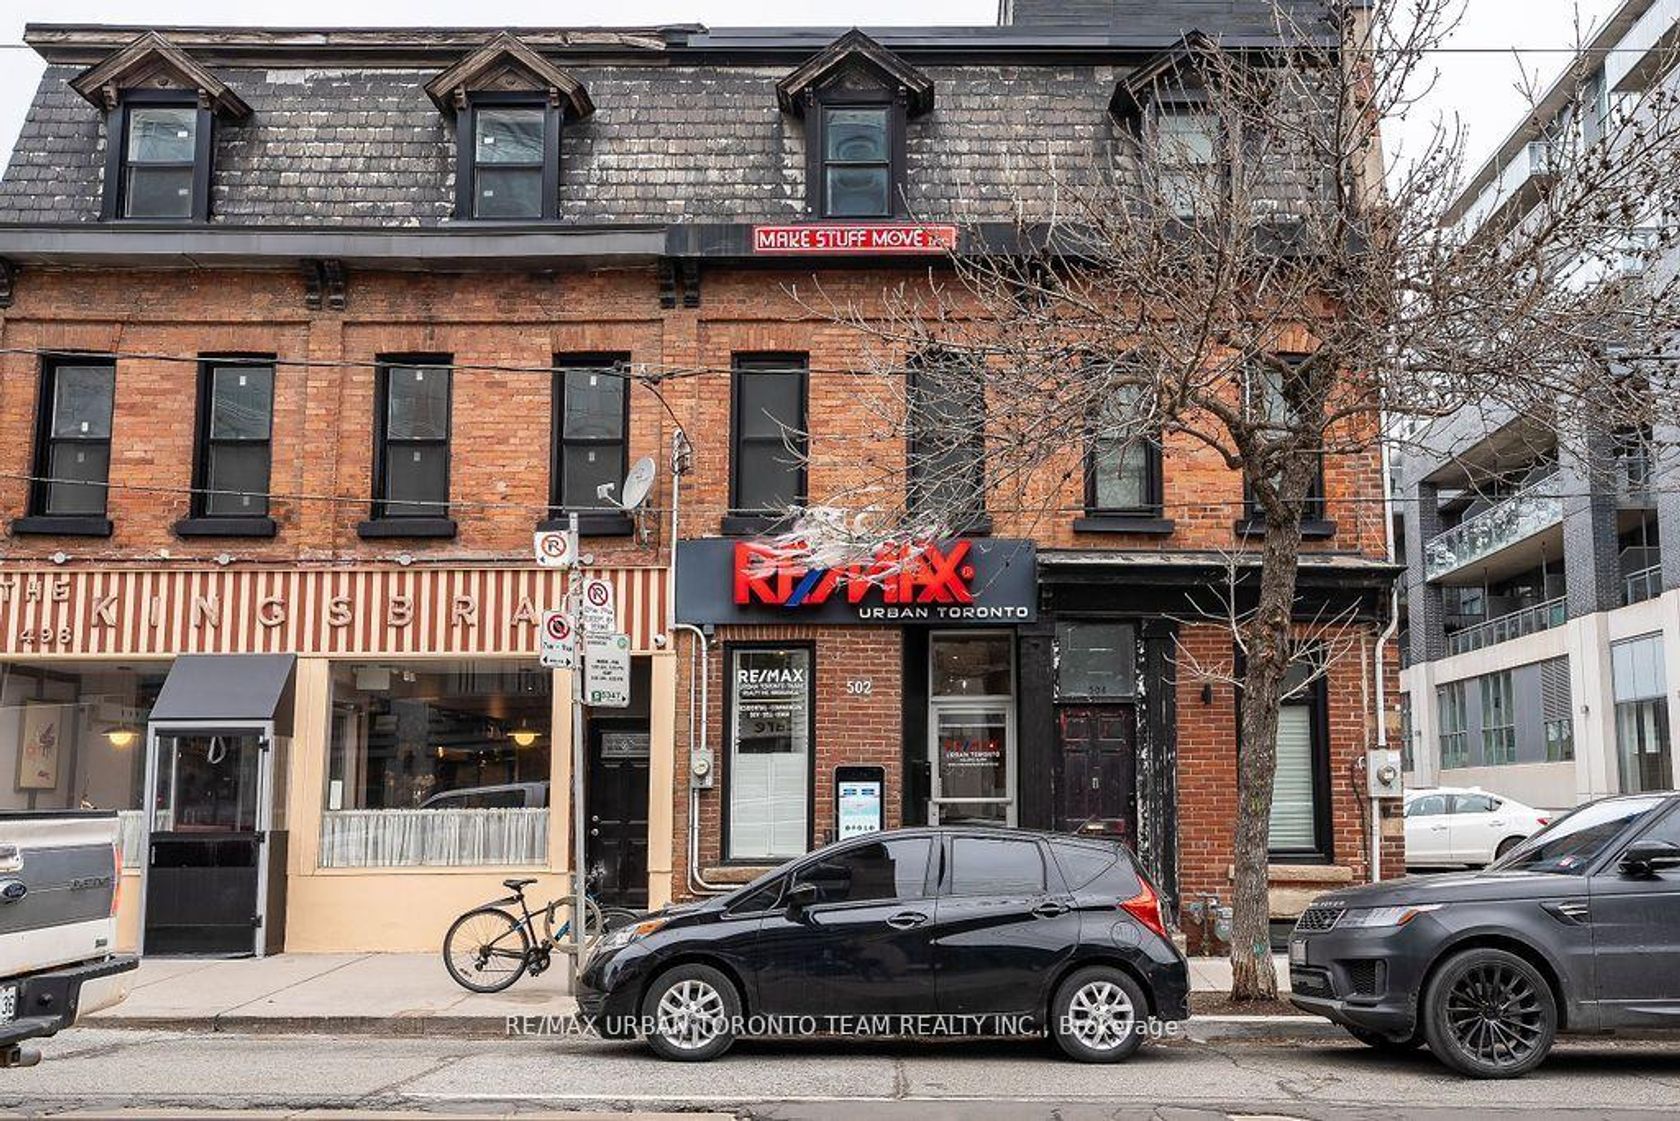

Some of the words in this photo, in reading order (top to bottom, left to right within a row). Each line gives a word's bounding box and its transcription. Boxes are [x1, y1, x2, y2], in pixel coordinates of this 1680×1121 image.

[759, 230, 810, 248] MAKE
[815, 230, 867, 247] STUFF
[872, 229, 924, 247] MOVE
[0, 581, 71, 602] THE
[859, 606, 929, 619] URBAN
[936, 606, 1029, 619] TORONTO
[19, 625, 73, 645] 498
[737, 669, 804, 683] RE/MAX
[846, 680, 872, 694] 502
